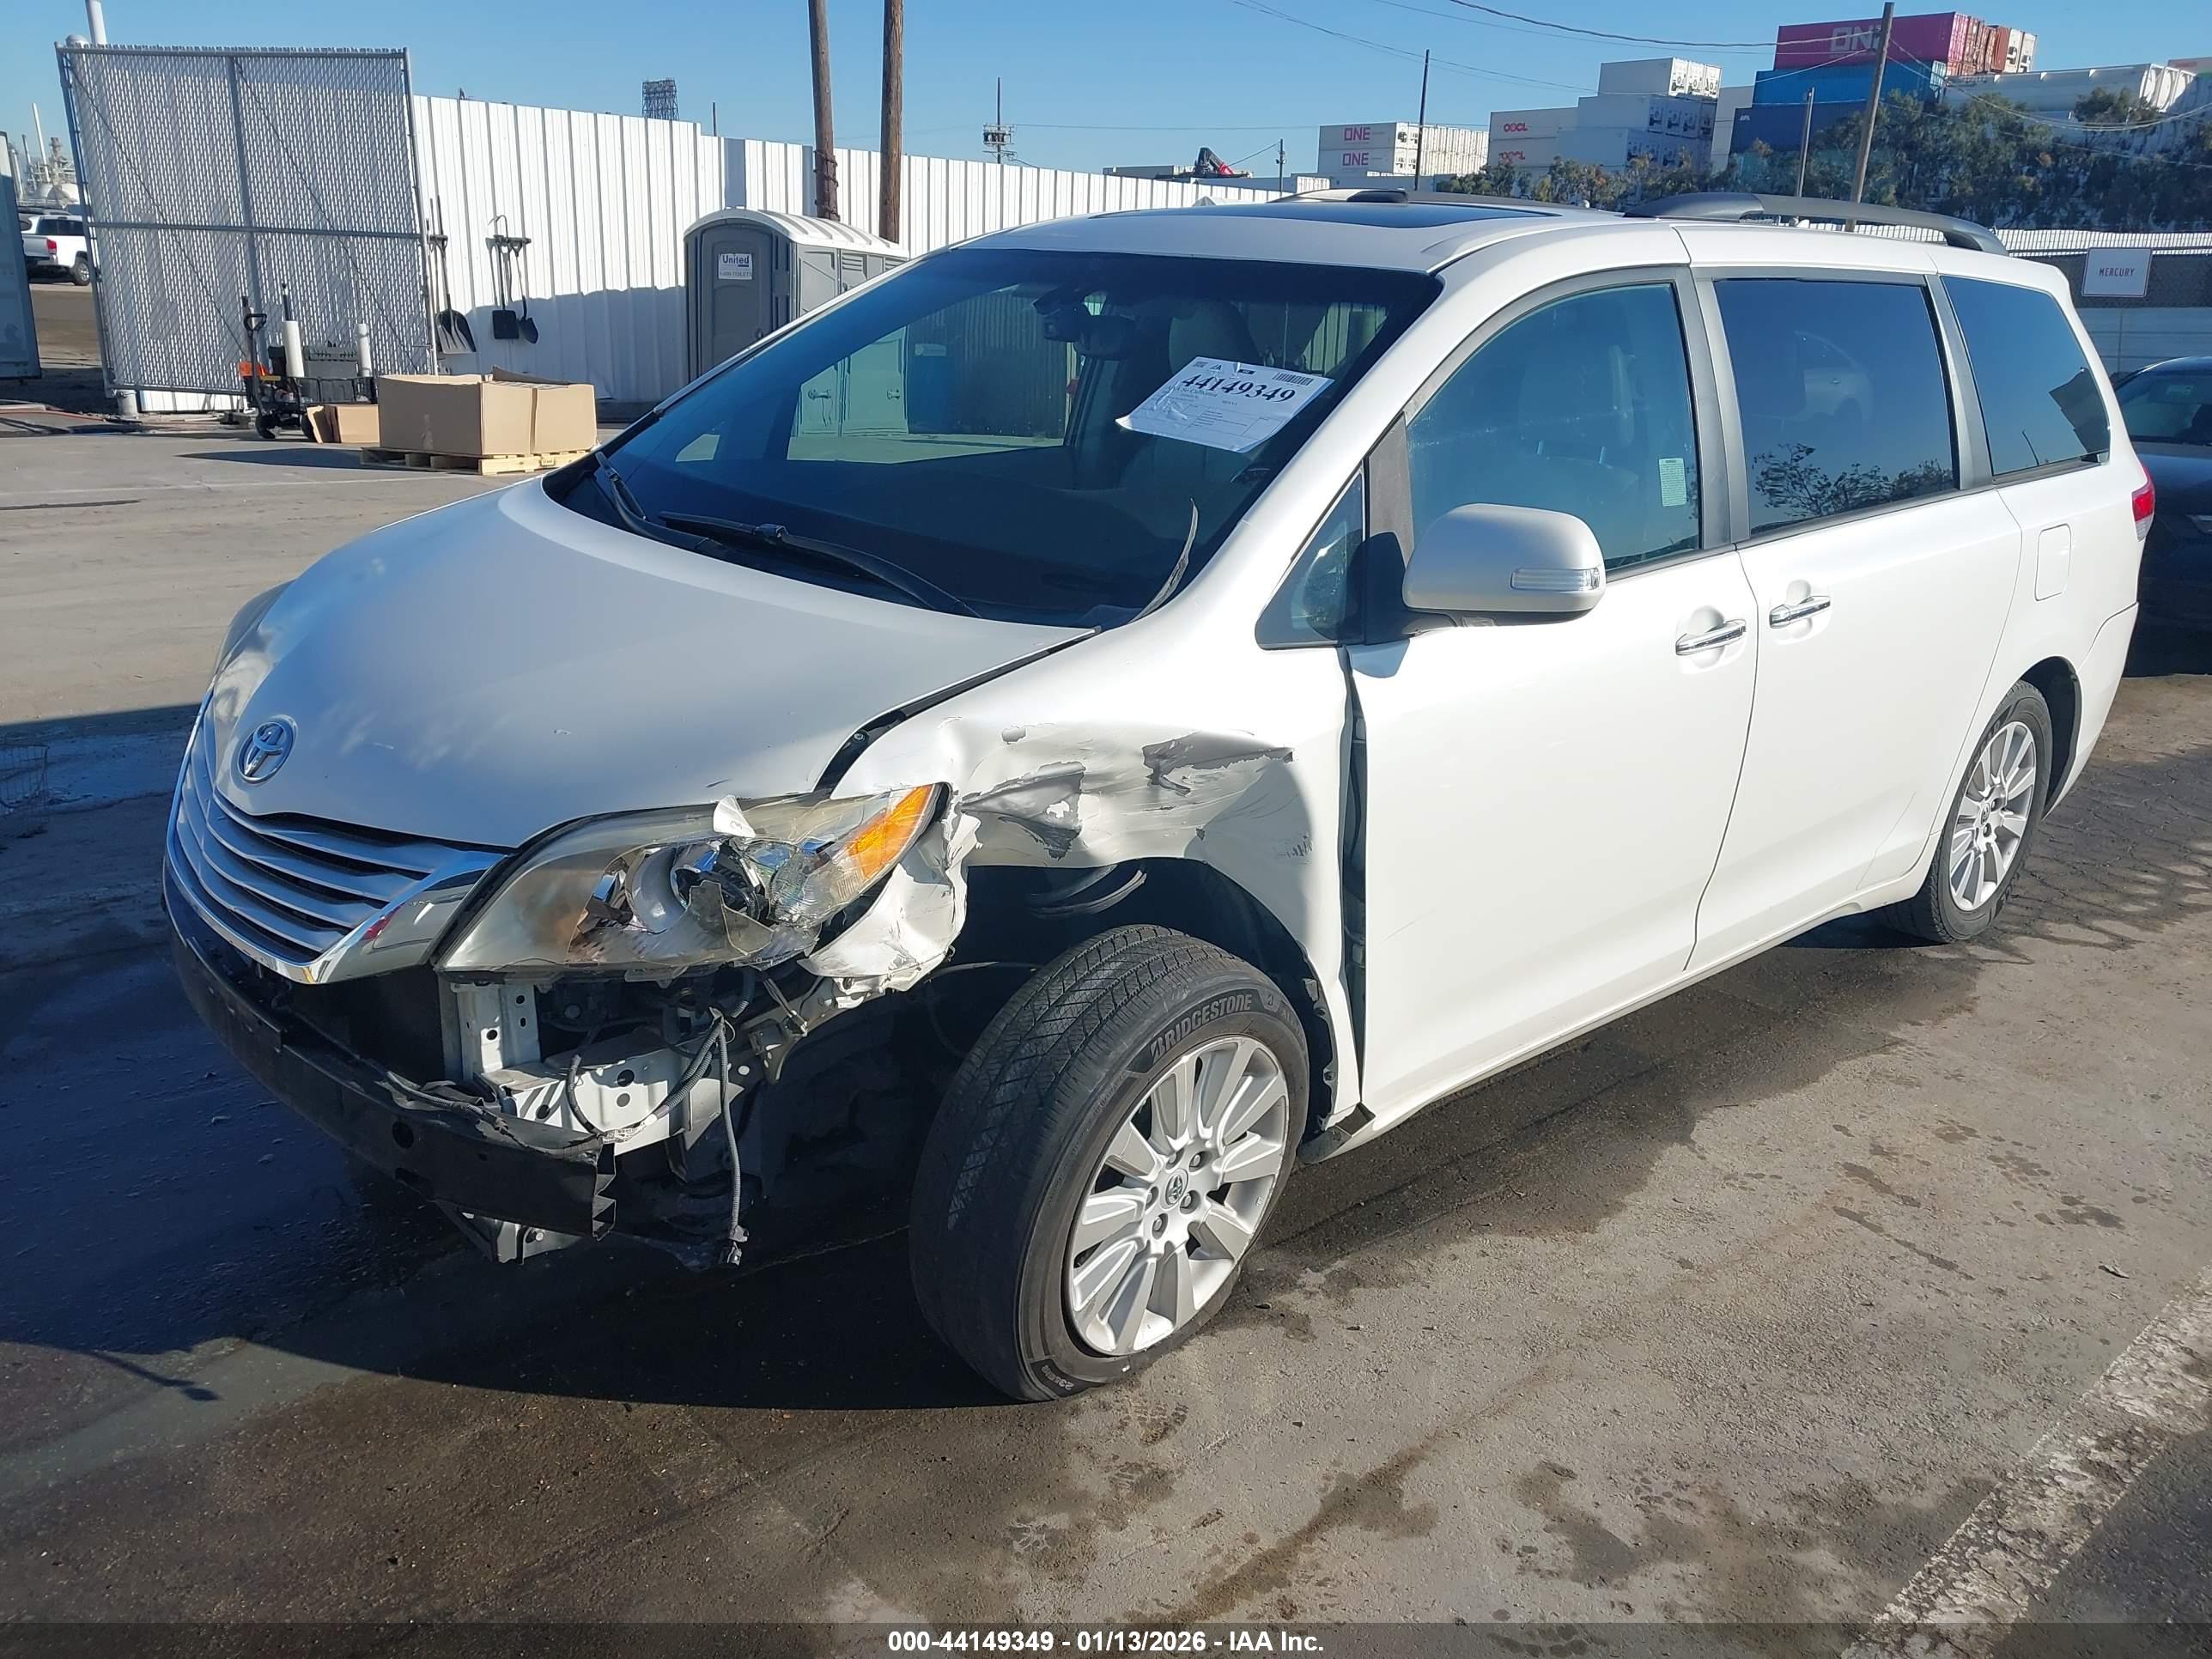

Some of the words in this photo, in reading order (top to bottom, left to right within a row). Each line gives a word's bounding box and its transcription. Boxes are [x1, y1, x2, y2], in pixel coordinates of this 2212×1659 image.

[1344, 127, 1370, 141] ONE
[1342, 152, 1369, 166] ONE
[722, 255, 750, 264] United
[2099, 267, 2136, 276] MERCURY
[1182, 374, 1296, 403] 44149349
[1150, 994, 1253, 1065] BRIDGESTONE
